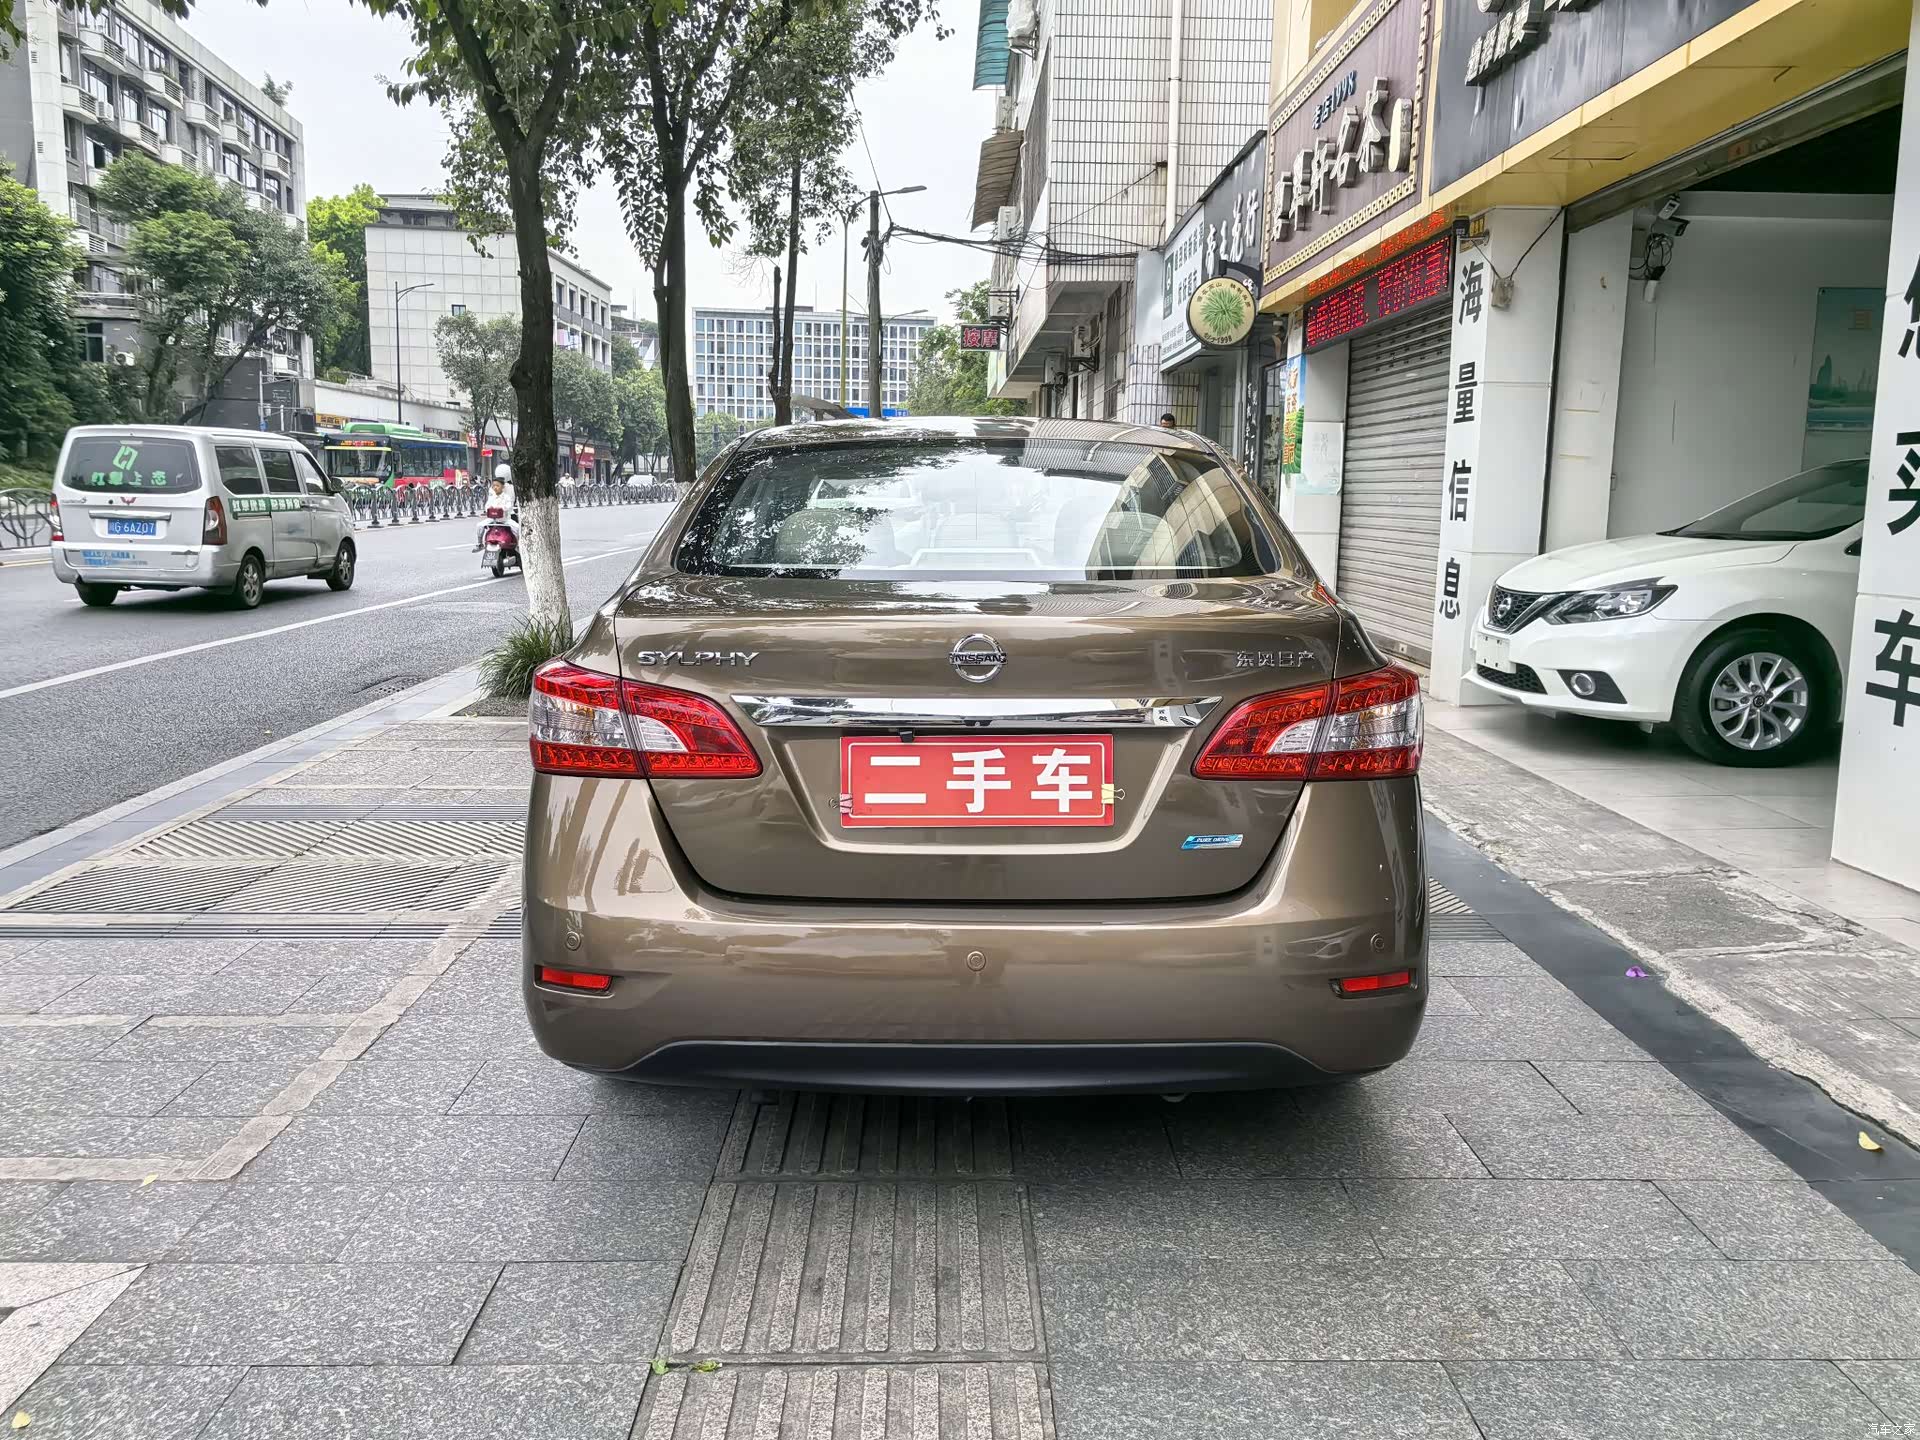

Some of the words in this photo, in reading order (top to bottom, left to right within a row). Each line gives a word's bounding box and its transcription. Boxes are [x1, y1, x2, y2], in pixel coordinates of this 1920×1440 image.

[963, 327, 999, 348] 按摩
[1438, 260, 1485, 620] 海量信息
[637, 650, 760, 667] SYLPHY
[955, 653, 1002, 663] NISSAN
[1235, 649, 1316, 669] 东风日产
[864, 748, 1093, 814] 二手车
